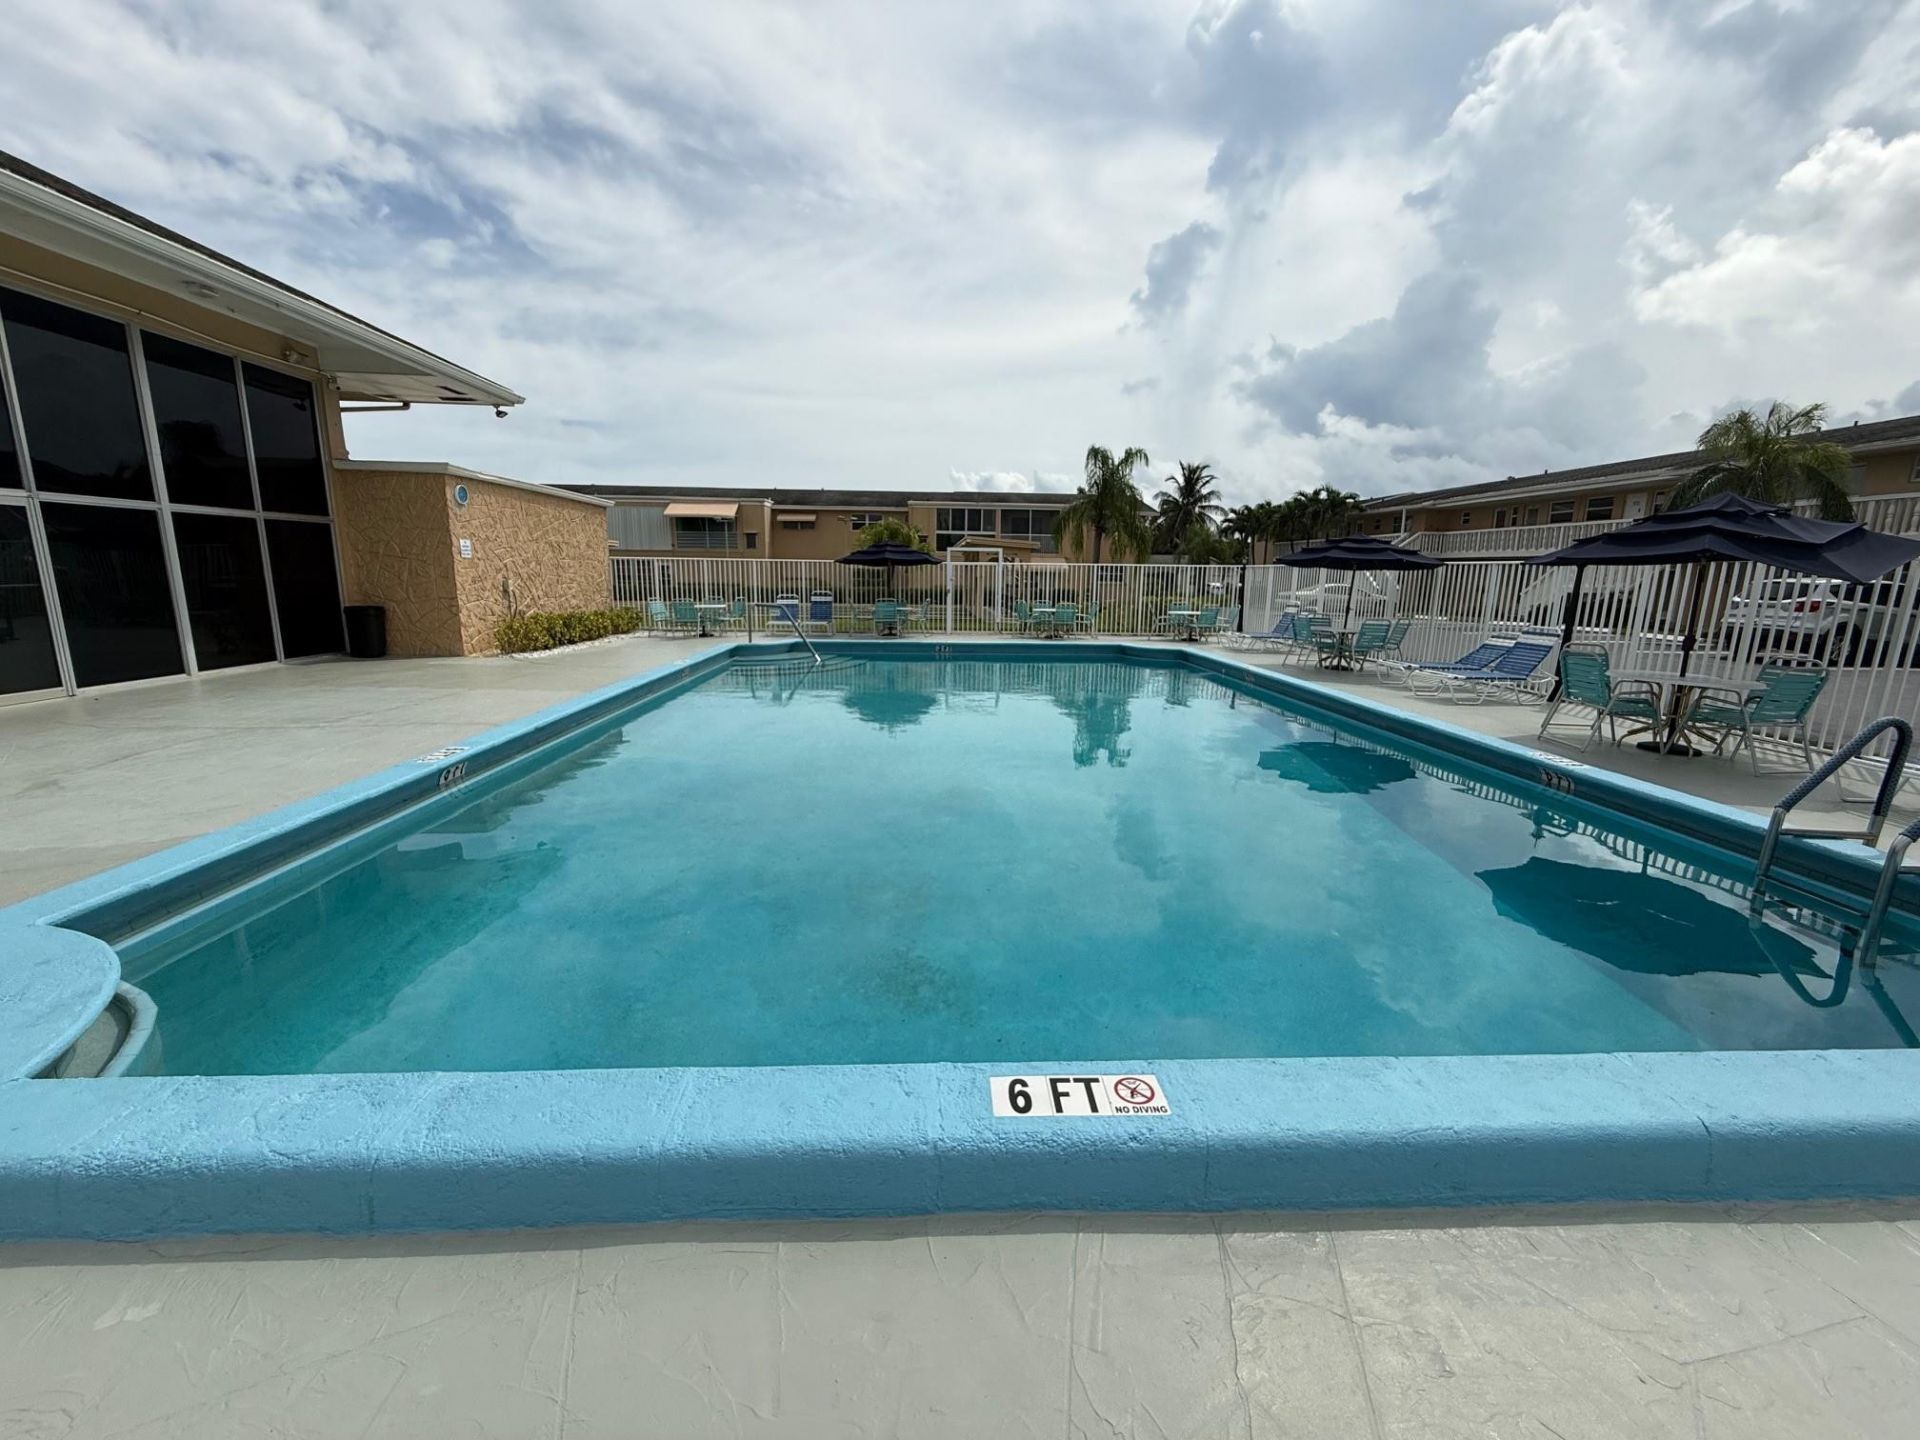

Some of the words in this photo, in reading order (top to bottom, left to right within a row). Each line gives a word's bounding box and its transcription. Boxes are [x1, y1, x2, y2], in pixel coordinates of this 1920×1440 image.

[1008, 1078, 1032, 1114] 6
[1049, 1077, 1100, 1113] FT
[1115, 1106, 1131, 1114] NO
[1132, 1105, 1168, 1114] DIVING
